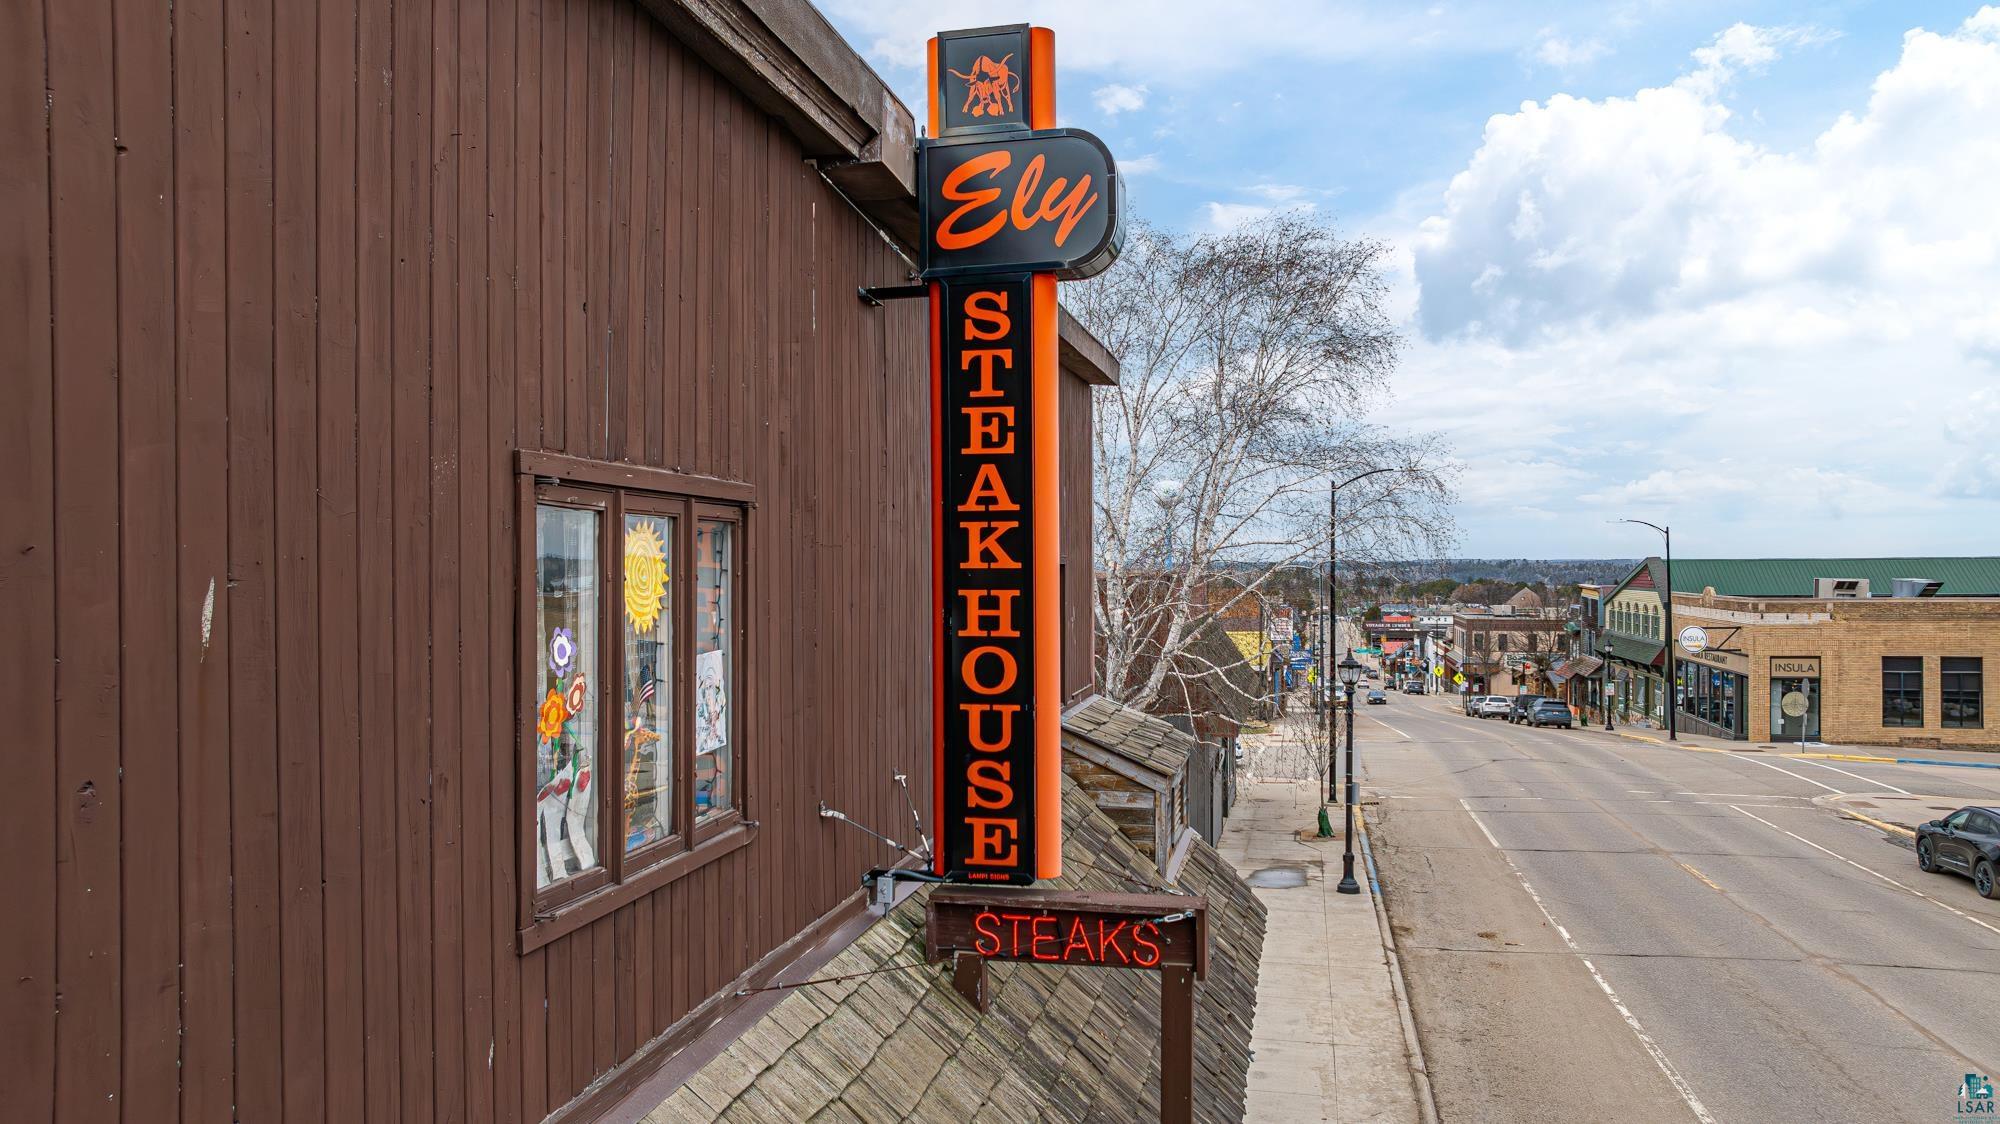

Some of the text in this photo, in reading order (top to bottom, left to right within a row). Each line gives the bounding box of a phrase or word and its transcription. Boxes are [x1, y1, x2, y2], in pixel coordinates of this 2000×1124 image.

[936, 151, 1097, 250] Ely
[1774, 663, 1816, 673] INSULA
[989, 873, 1010, 881] SIGNS
[975, 912, 1160, 966] STEAKS
